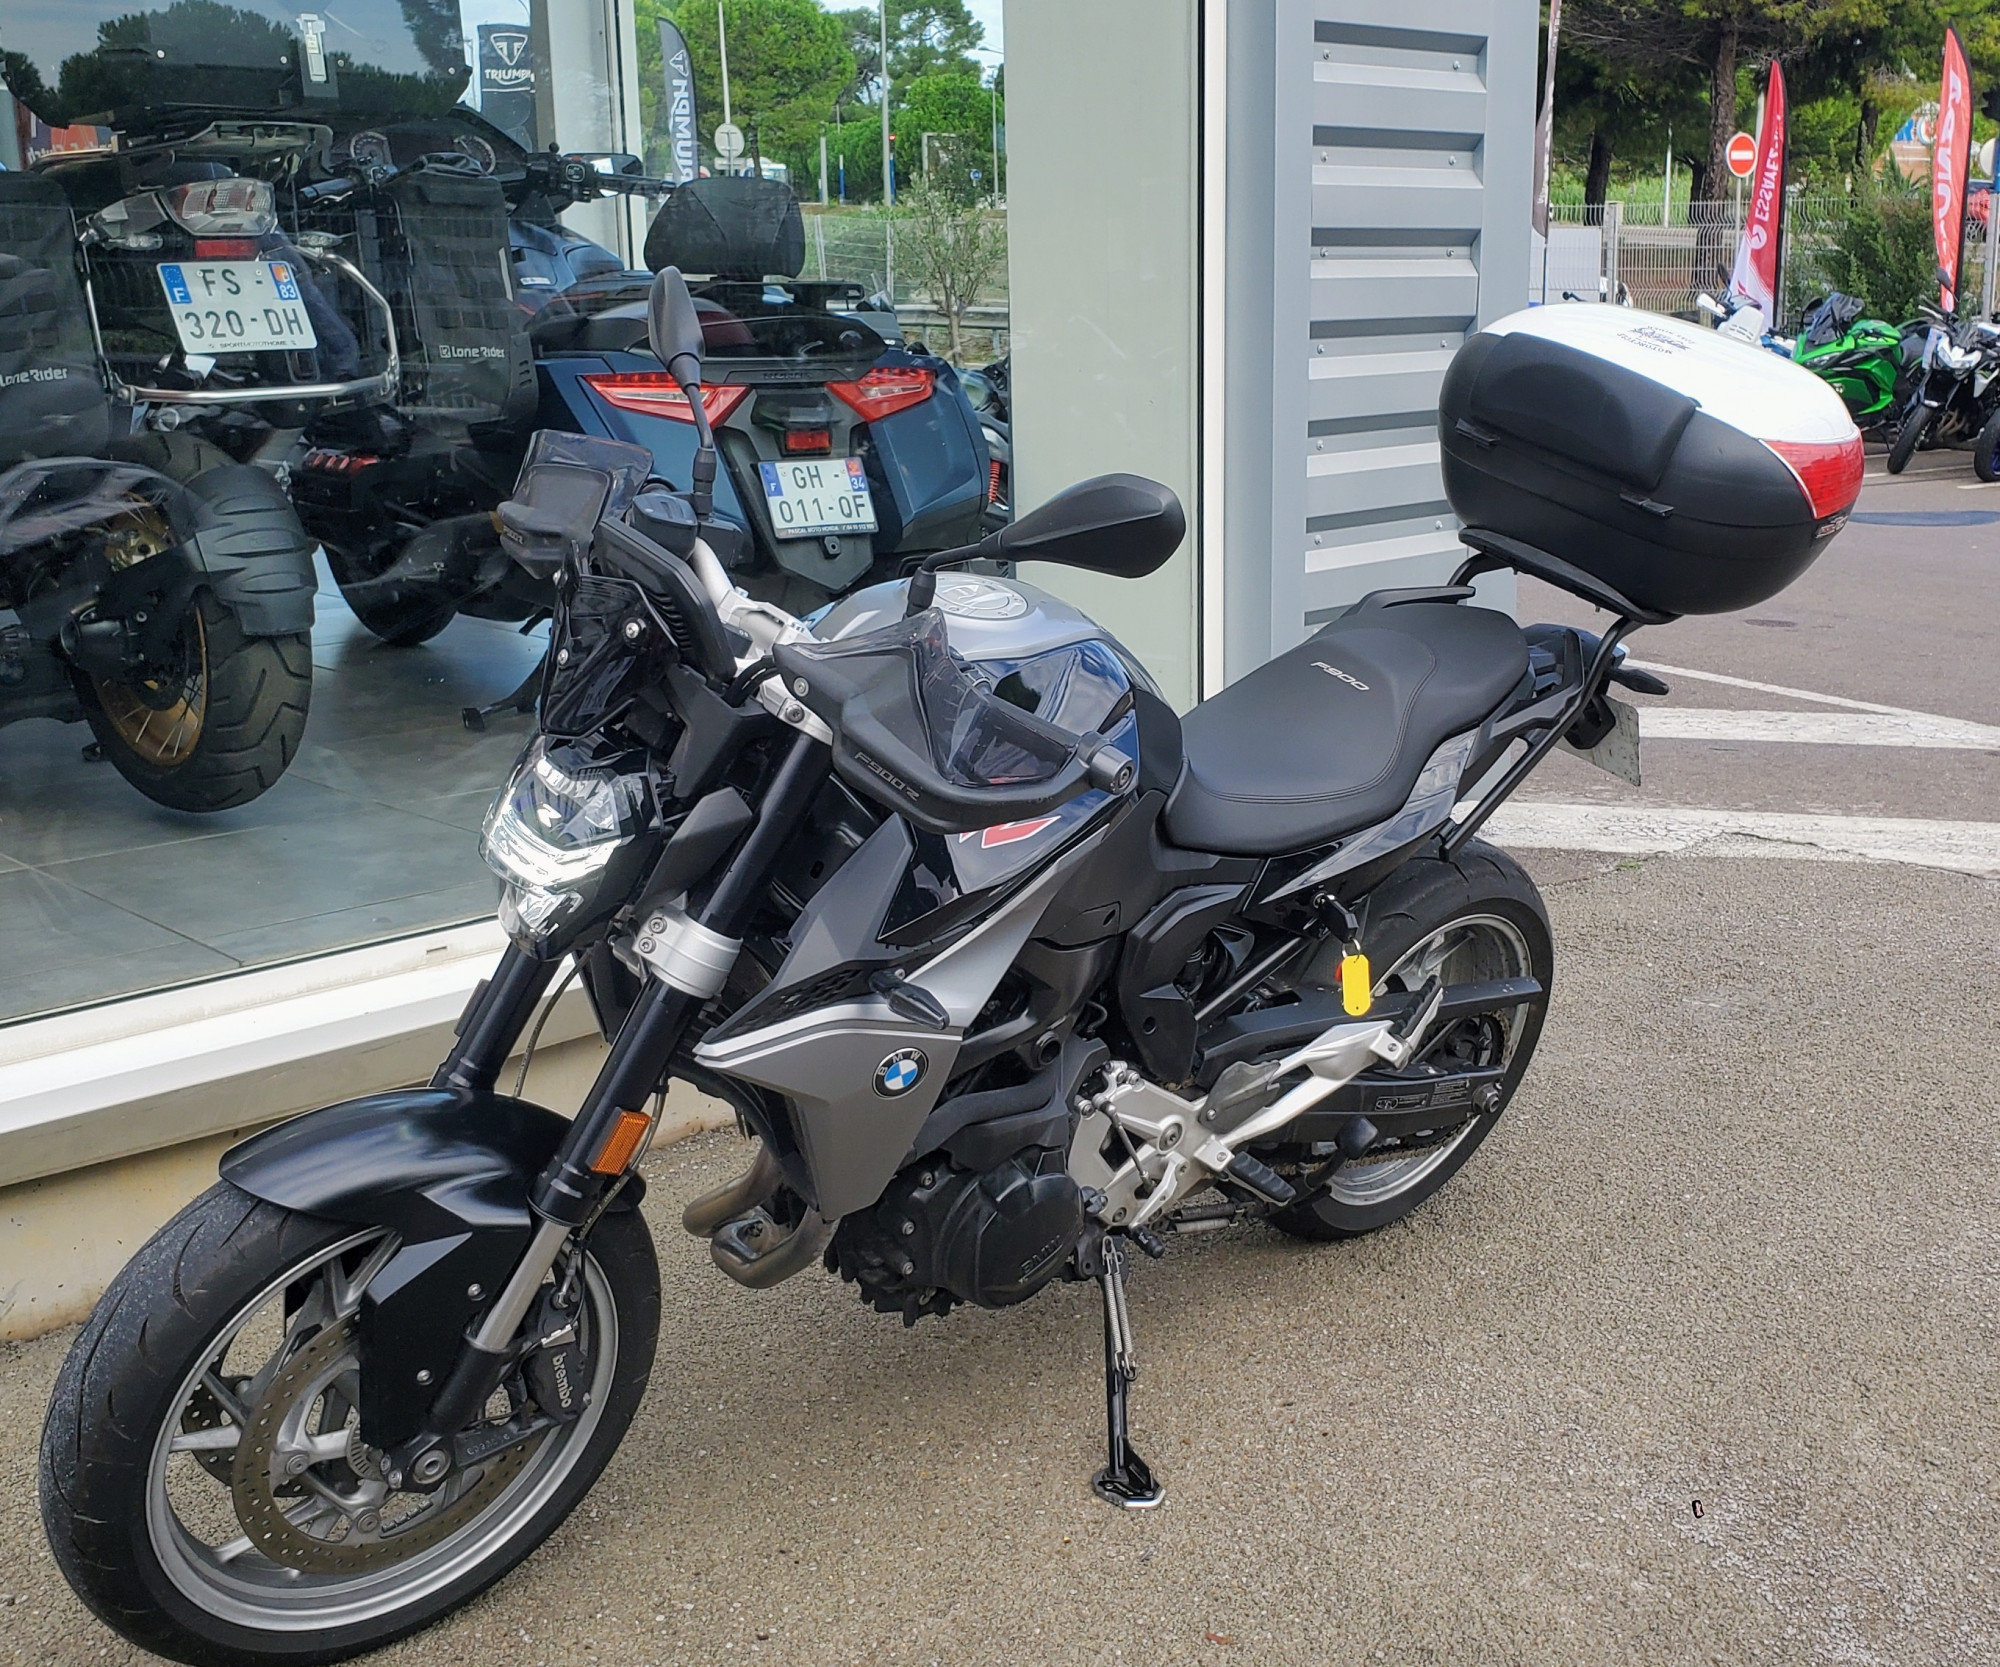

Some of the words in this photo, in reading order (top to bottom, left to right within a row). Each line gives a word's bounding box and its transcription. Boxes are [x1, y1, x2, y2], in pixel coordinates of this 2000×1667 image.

[173, 287, 186, 302] F
[199, 268, 241, 296] FS
[278, 284, 297, 299] 83
[184, 308, 304, 339] 320-DH
[792, 465, 824, 489] GH
[851, 478, 865, 490] 34
[779, 495, 866, 523] 011-QF
[1310, 661, 1370, 691] F900
[877, 1050, 922, 1077] BMW
[552, 1352, 574, 1409] brembo
